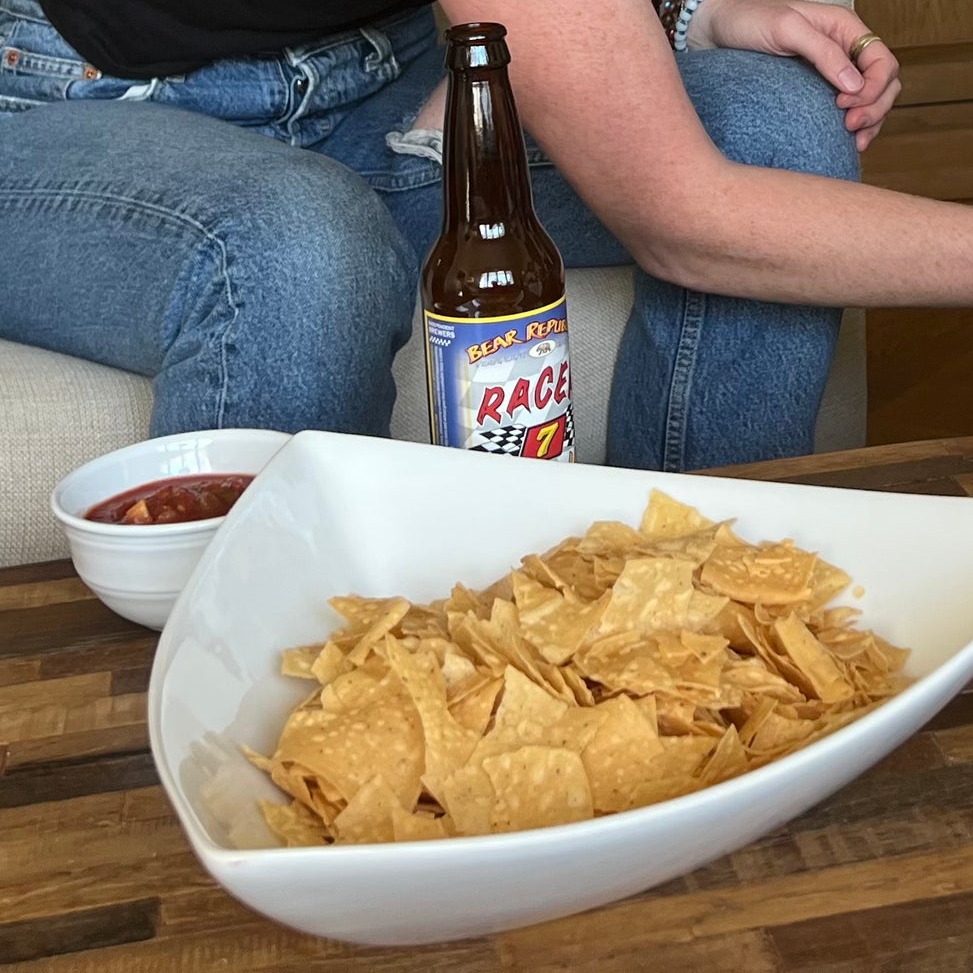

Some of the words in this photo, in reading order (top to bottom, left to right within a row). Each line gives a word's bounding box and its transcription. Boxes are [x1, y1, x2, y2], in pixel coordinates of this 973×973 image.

[466, 329, 523, 364] BEAR
[477, 361, 572, 426] RACE
[536, 422, 559, 457] 7
